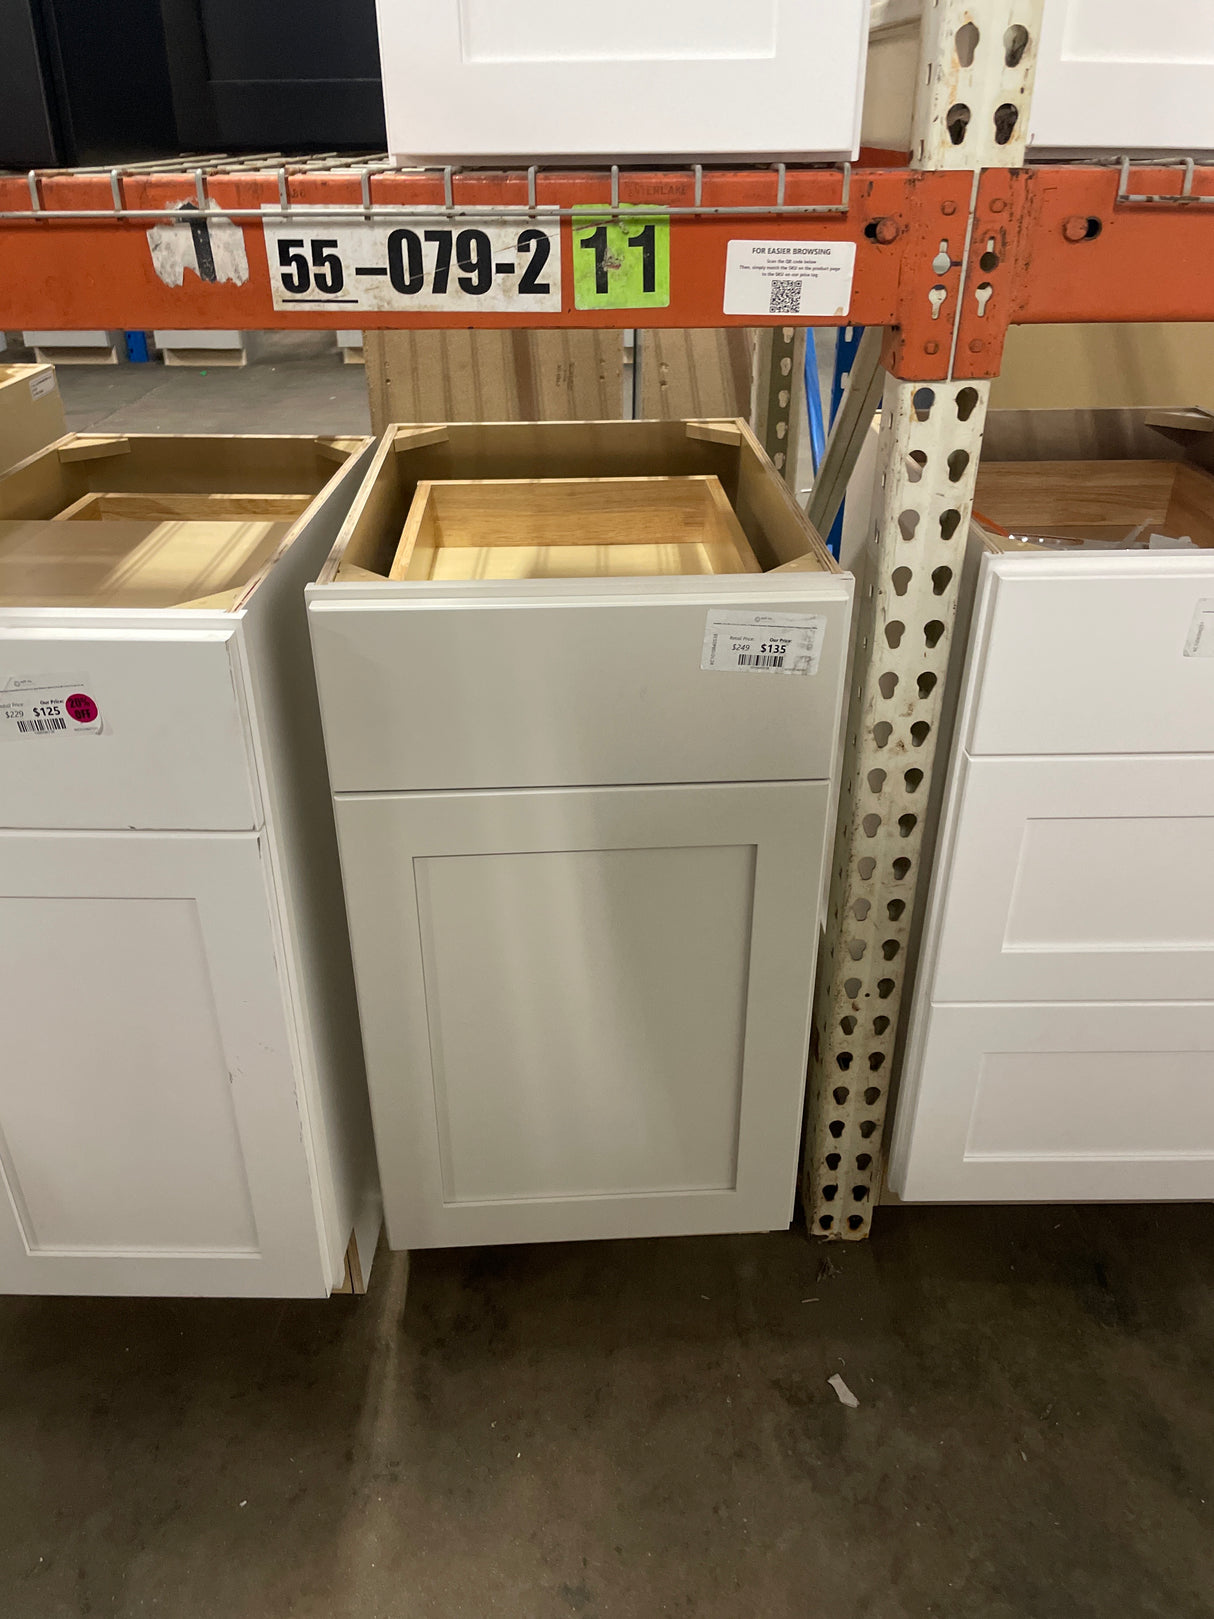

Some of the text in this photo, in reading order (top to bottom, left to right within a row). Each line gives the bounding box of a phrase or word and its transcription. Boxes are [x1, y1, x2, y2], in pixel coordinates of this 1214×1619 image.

[732, 643, 750, 652] $249
[760, 643, 787, 654] $135
[69, 698, 90, 709] 20%
[6, 710, 24, 718] $229
[32, 706, 60, 718] $125
[74, 709, 91, 720] OFF
